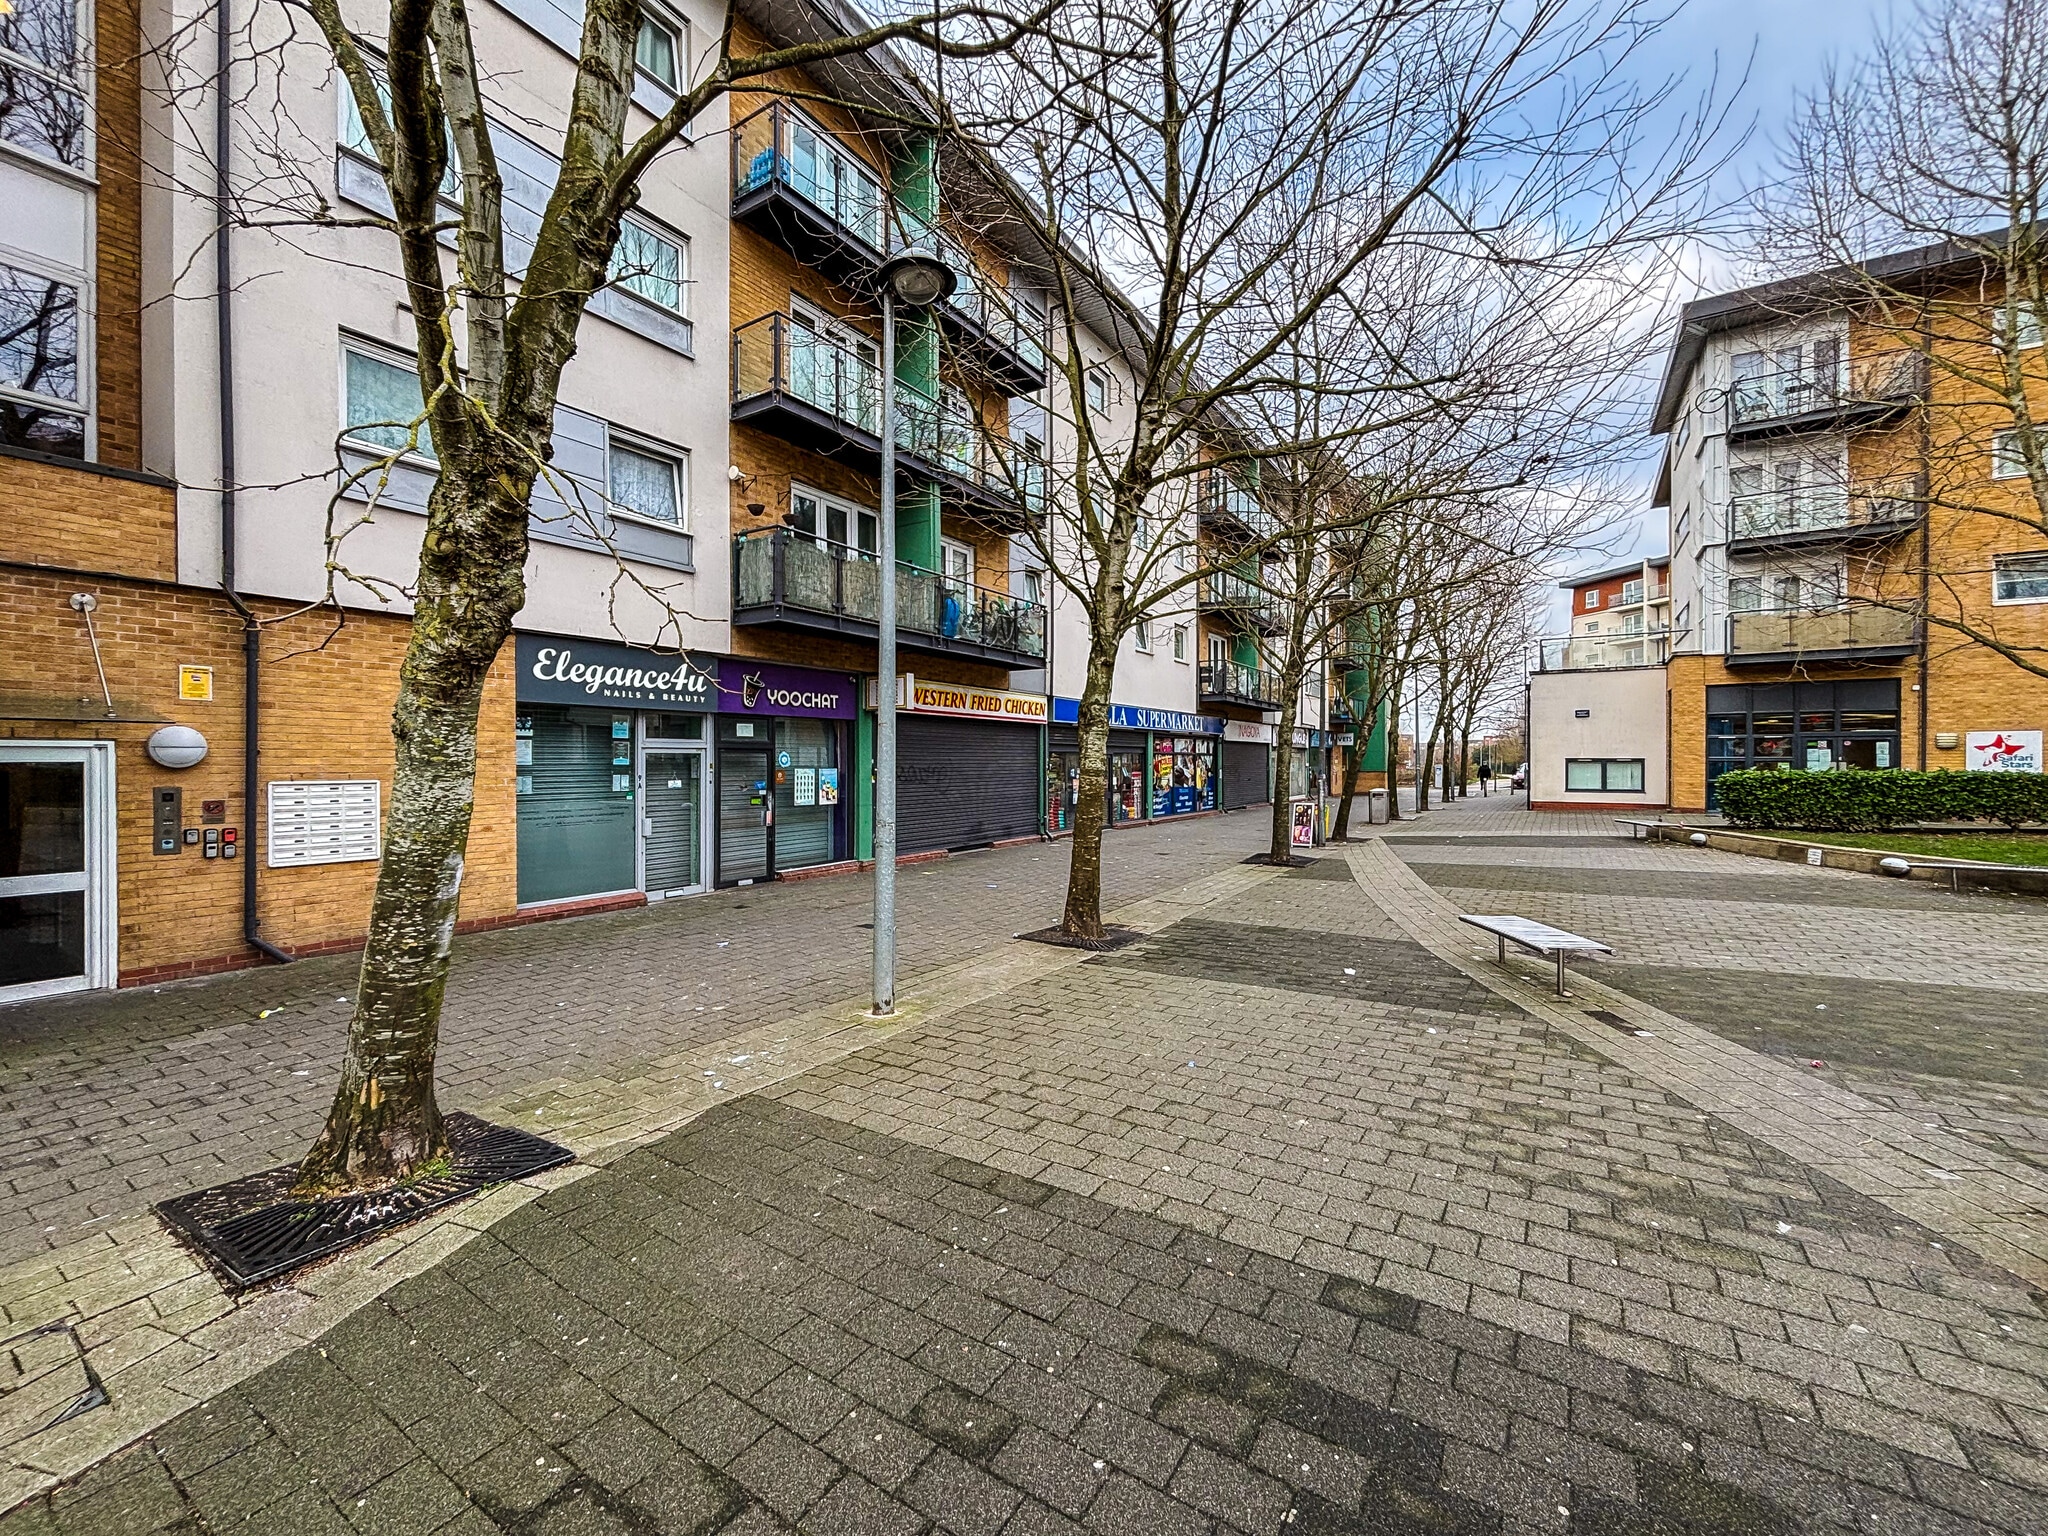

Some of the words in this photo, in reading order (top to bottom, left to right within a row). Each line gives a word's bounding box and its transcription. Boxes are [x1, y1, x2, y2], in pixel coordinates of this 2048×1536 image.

[532, 648, 707, 694] Elegance4u
[604, 689, 641, 699] NAILS
[662, 693, 706, 703] BEAUTY
[767, 688, 839, 709] YOOCHAT
[969, 695, 1002, 712] FRIED
[1004, 699, 1046, 716] CHICKEN
[1137, 709, 1204, 731] SUPERMARKET
[1998, 754, 2034, 762] Safari
